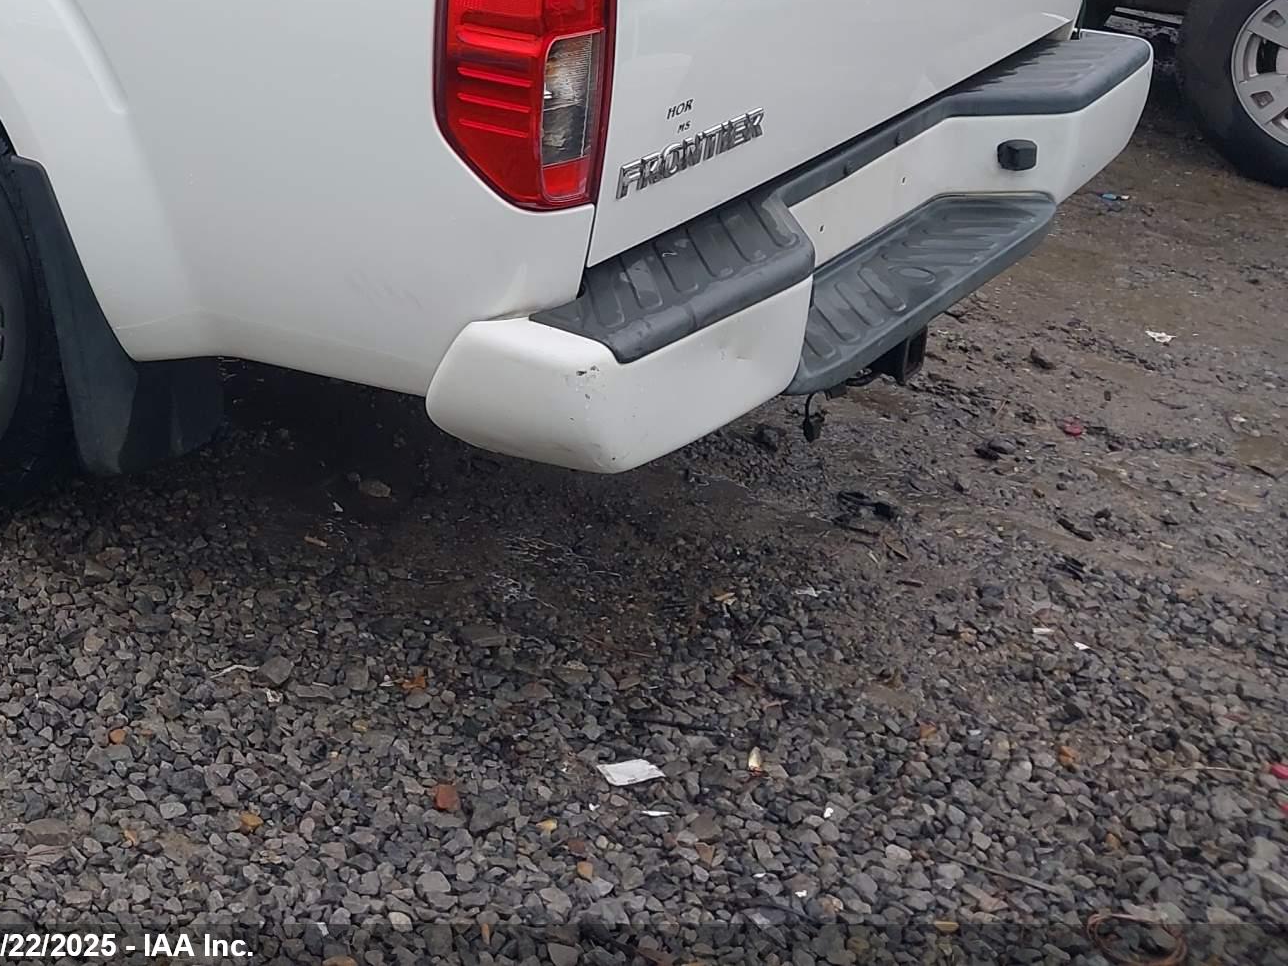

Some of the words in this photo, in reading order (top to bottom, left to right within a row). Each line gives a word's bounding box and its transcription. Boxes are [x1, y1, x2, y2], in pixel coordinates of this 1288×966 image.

[666, 98, 694, 120] HOR
[677, 120, 691, 134] MS
[615, 107, 765, 200] FRONTIER
